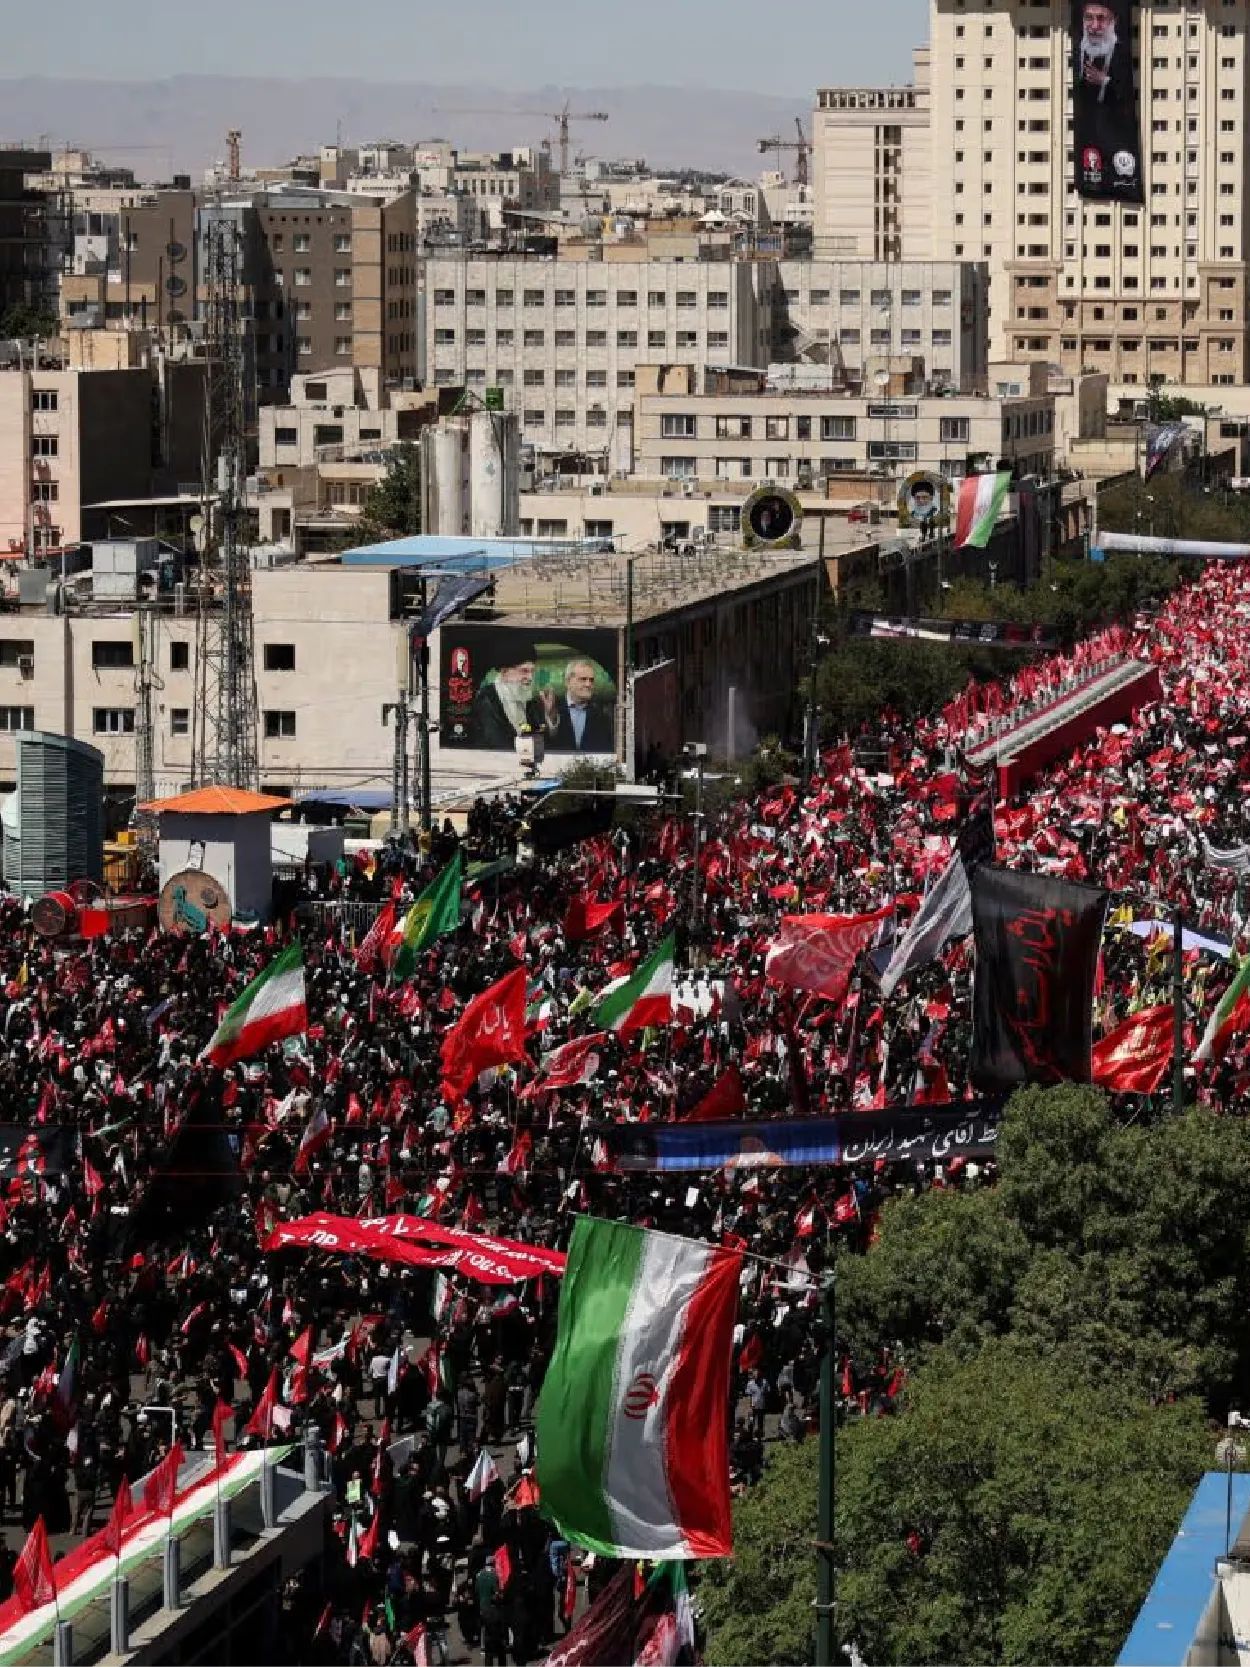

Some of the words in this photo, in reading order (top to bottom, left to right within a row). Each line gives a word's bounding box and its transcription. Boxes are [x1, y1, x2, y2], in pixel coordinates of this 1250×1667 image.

[842, 1127, 894, 1163] ایران
[895, 1117, 935, 1160] شهید
[932, 1111, 979, 1158] آقای
